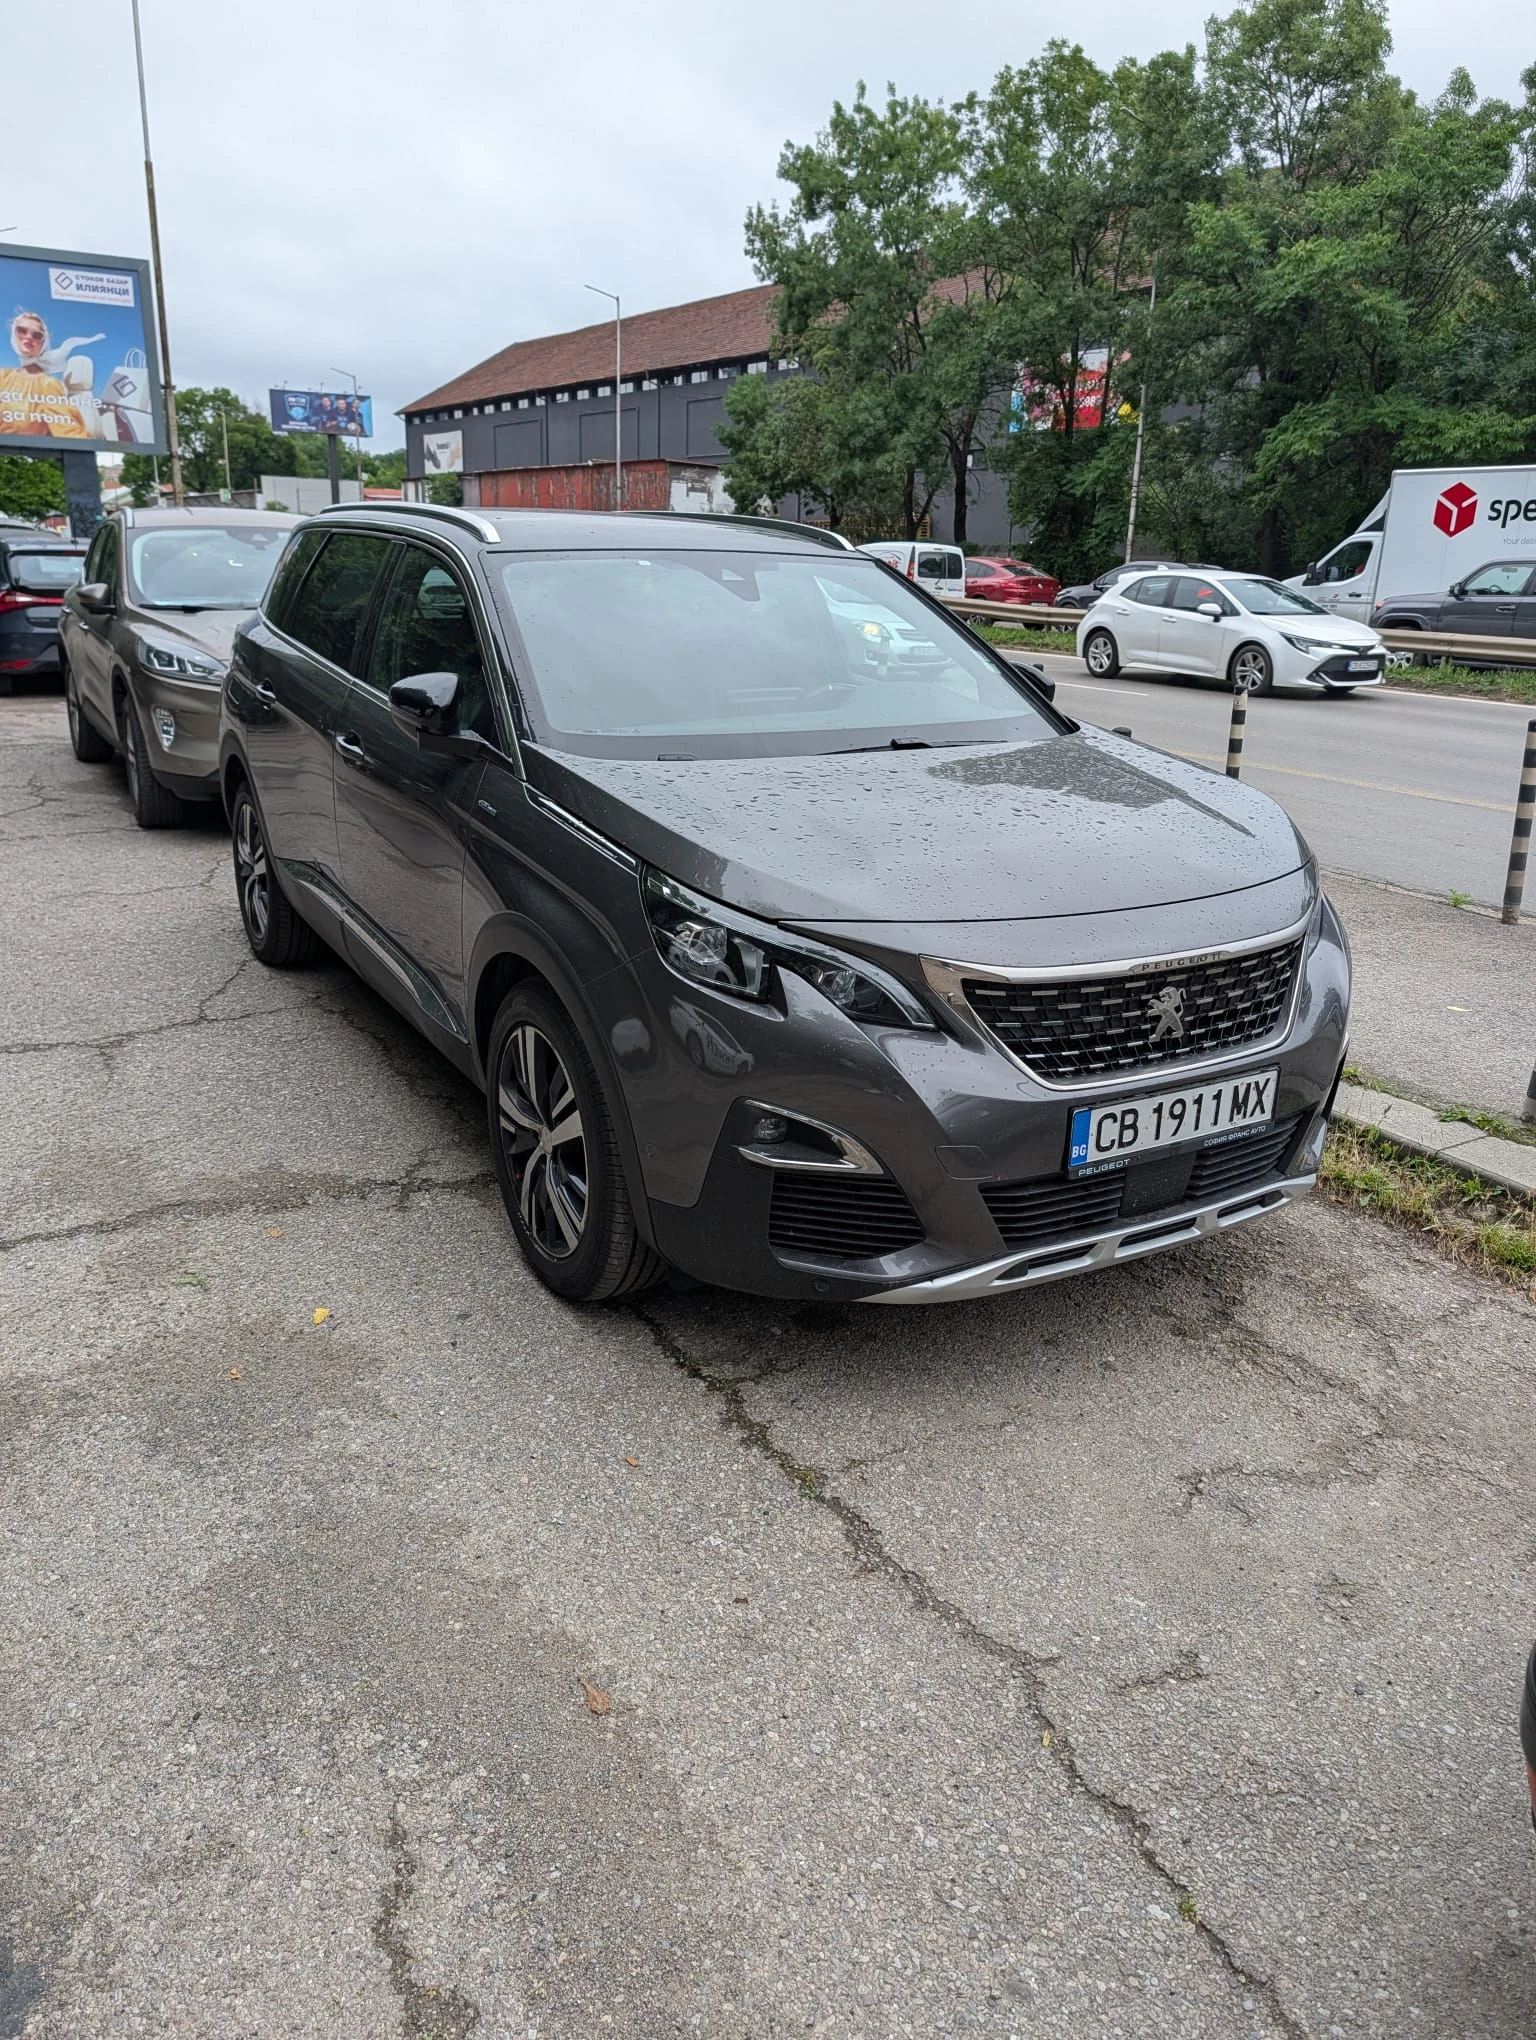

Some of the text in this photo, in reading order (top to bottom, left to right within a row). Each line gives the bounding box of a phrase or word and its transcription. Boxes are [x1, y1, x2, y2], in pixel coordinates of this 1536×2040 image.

[75, 274, 128, 285] СТОКОВ БАЗАР
[75, 283, 129, 296] ИЛИЯНЦИ
[0, 391, 23, 403] за
[2, 410, 25, 424] за
[1142, 952, 1220, 971] PEUGEOT
[1096, 1077, 1271, 1152] CB 1911 MX
[1203, 1125, 1267, 1147] СОФИЯ ФРАНС АУТО
[1072, 1144, 1087, 1158] BG
[1079, 1159, 1131, 1176] PEUGEOT
